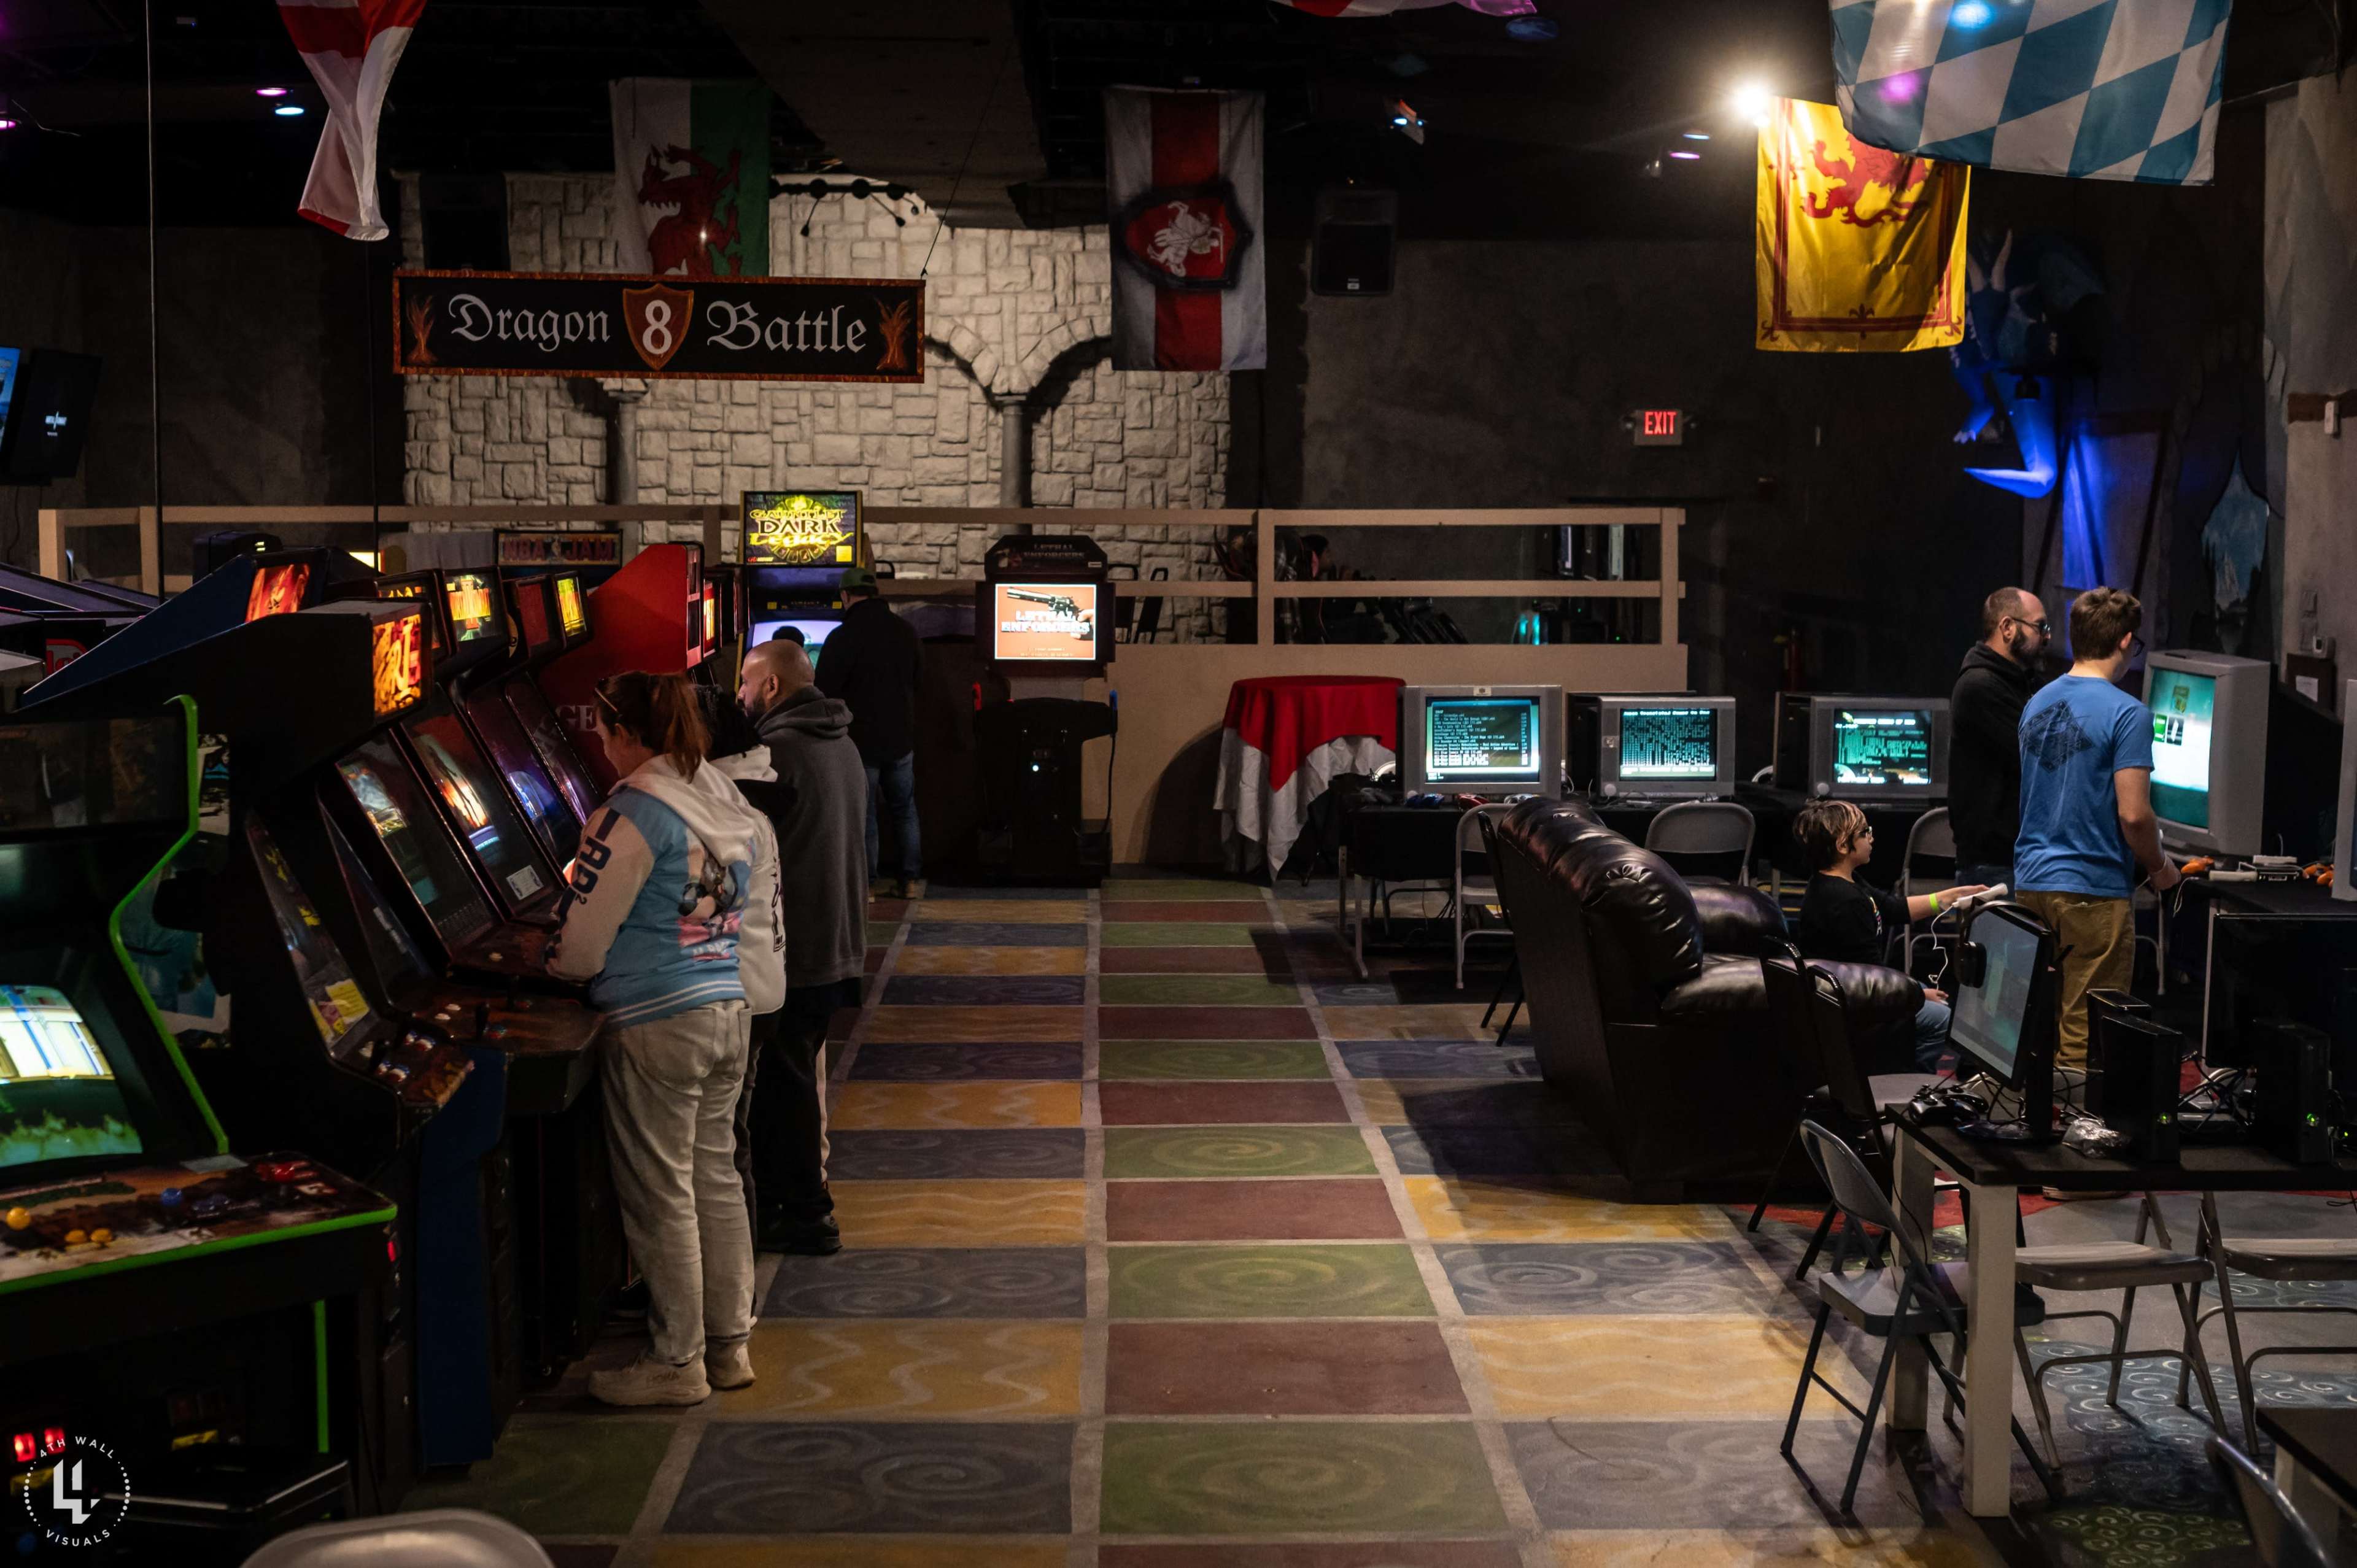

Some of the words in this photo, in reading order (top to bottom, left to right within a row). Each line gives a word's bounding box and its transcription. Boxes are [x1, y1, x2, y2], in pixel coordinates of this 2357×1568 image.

[448, 293, 611, 353] Dragon
[641, 299, 673, 355] 8
[706, 300, 867, 353] Battle
[1644, 411, 1677, 434] EXIT
[749, 509, 848, 519] GAUNTLET
[756, 518, 843, 536] DARK
[503, 539, 546, 561] NBA
[564, 539, 614, 562] JAM
[1015, 610, 1076, 622] LETHAL
[1001, 621, 1090, 633] ENFORCERS
